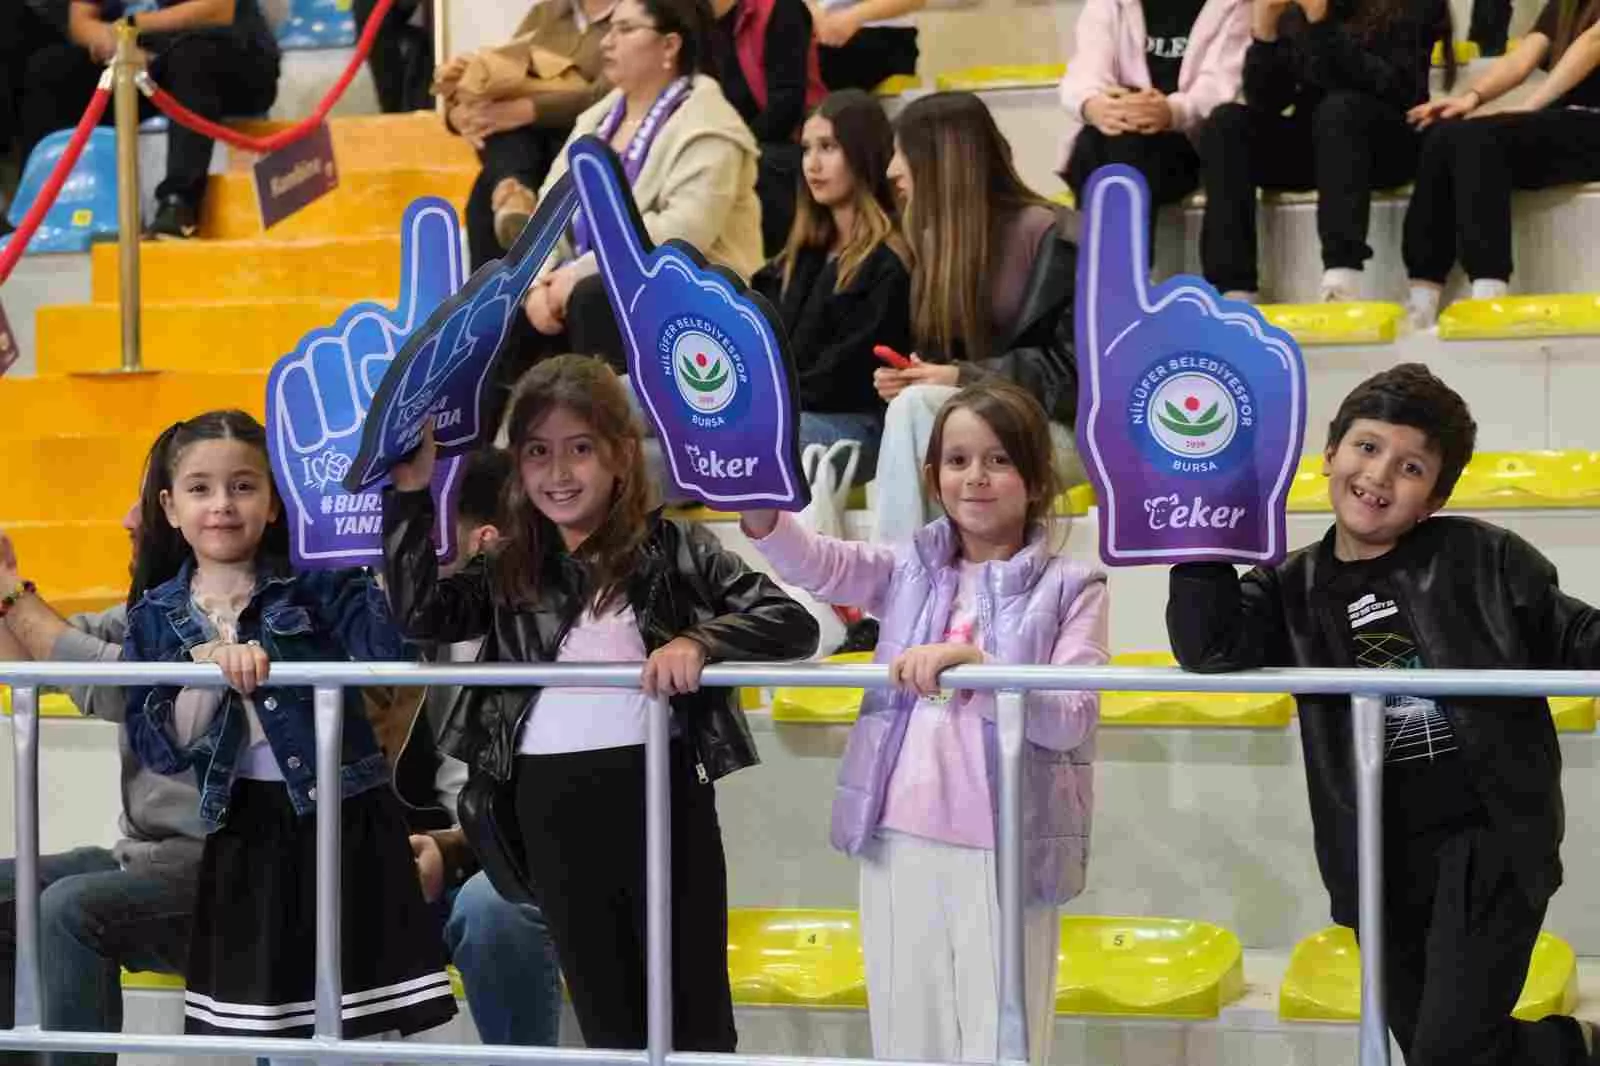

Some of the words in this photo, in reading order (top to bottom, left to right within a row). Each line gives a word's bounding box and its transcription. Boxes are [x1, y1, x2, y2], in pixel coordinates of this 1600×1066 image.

[1128, 365, 1169, 424] NİLÜFER
[1168, 356, 1253, 427] BELEDİYESPOR
[691, 415, 726, 428] BURSA
[1172, 459, 1219, 472] BURSA
[334, 515, 383, 536] YANI
[807, 934, 817, 945] 4
[1114, 934, 1125, 946] 5
